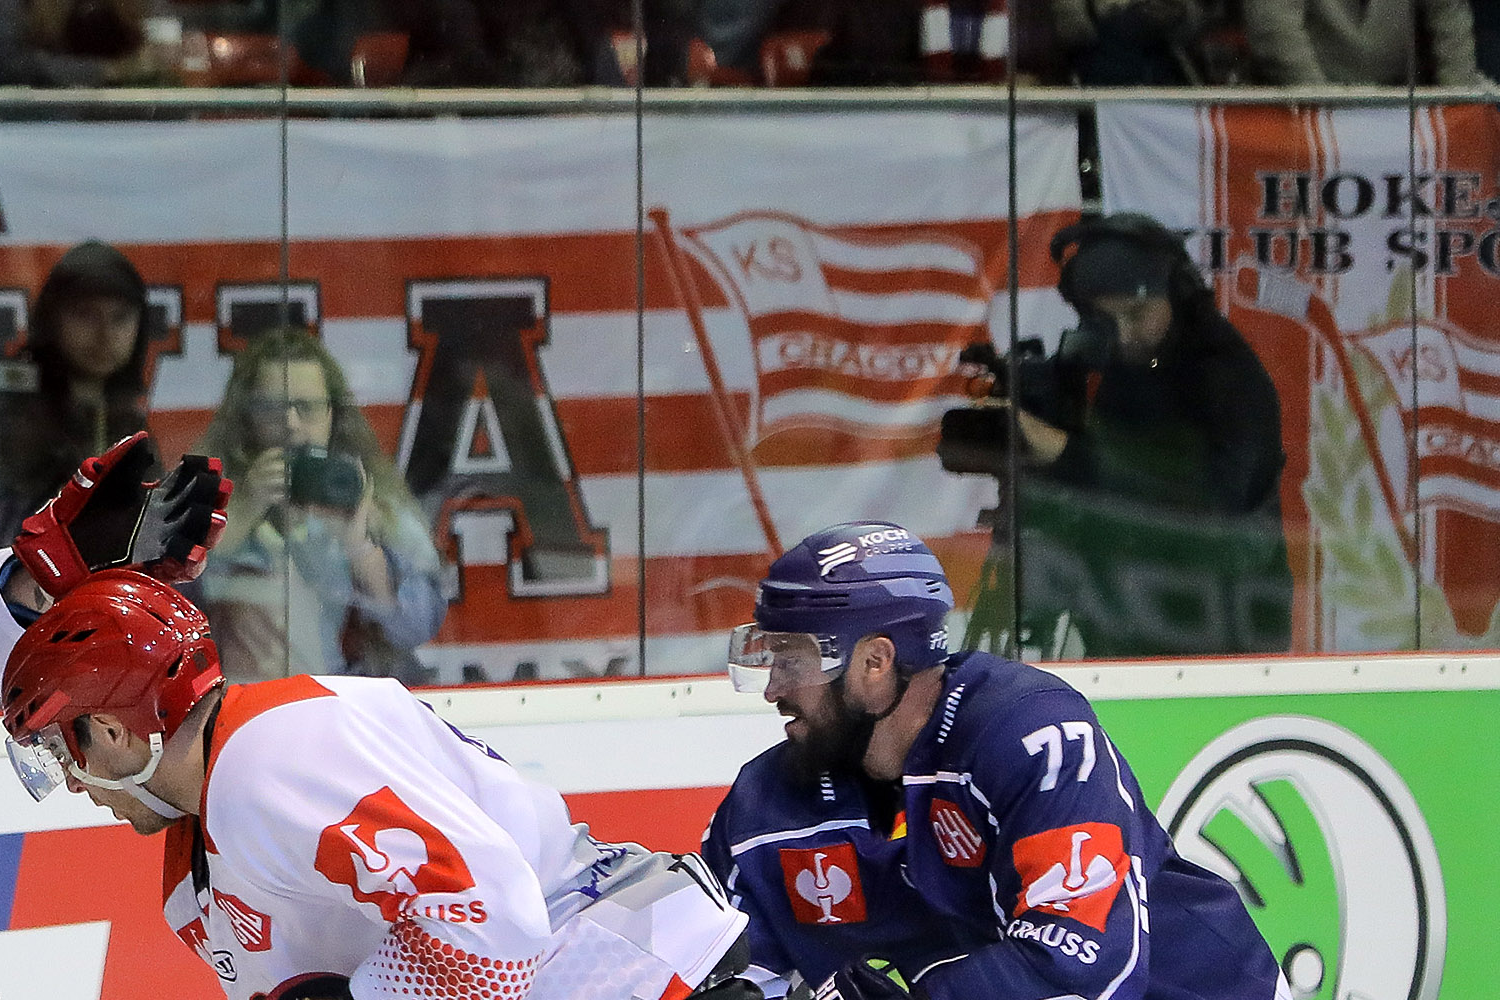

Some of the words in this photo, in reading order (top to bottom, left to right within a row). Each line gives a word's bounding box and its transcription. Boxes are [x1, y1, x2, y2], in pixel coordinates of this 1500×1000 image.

[857, 527, 911, 548] KOCH
[1021, 721, 1098, 793] 77
[933, 806, 983, 860] CHL
